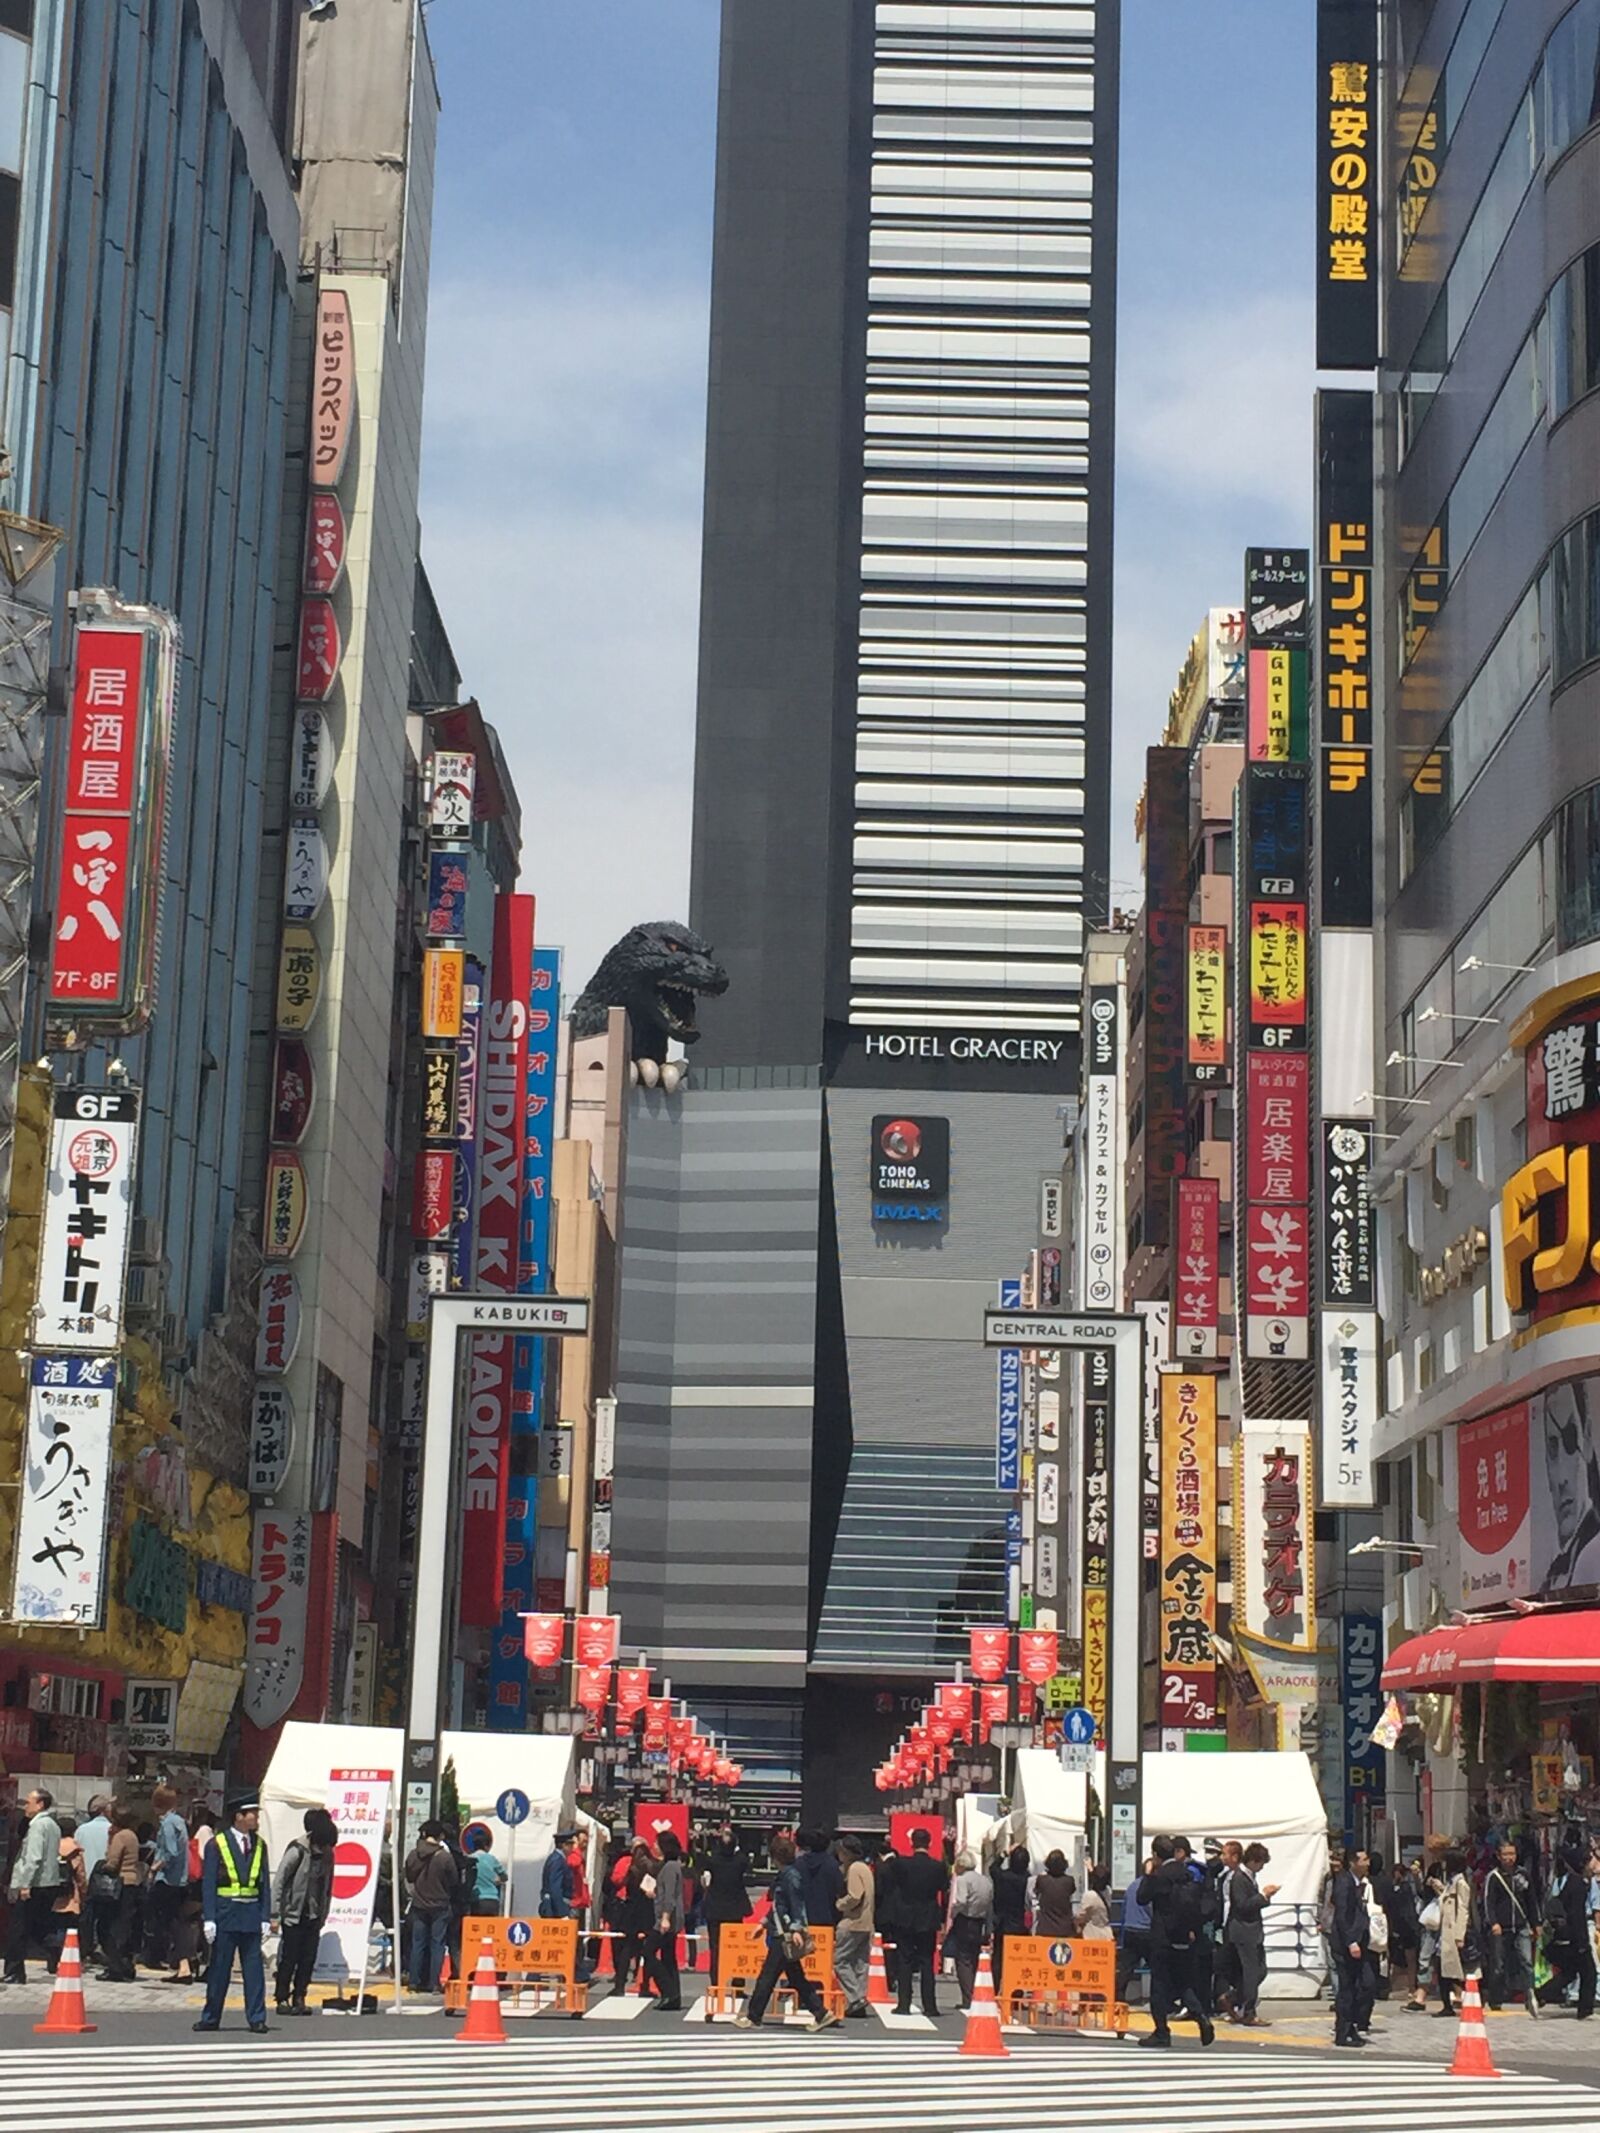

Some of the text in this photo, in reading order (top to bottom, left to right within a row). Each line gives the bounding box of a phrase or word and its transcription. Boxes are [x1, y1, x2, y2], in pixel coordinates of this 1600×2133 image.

[1329, 62, 1368, 281] 驚安の殿堂
[311, 518, 337, 570] つぼ八
[303, 624, 332, 676] つぼ八
[1269, 656, 1288, 738] Garam
[79, 669, 127, 799] 居酒屋
[294, 792, 317, 805] 6F
[57, 830, 122, 942] つぼ八
[1264, 881, 1292, 894] 7F
[285, 955, 314, 1006] 虎の子
[282, 1015, 299, 1026] 4F
[866, 1035, 1063, 1060] HOTEL GRACERY
[1263, 1028, 1293, 1047] 6F
[426, 1056, 449, 1123] 山内農場
[1196, 1067, 1217, 1080] 6F
[76, 1094, 121, 1118] 6F
[480, 1000, 527, 1209] SHIDAX
[76, 1139, 91, 1171] 元祖
[93, 1138, 112, 1171] 東京
[1094, 1083, 1108, 1234] ネットカフェ & カプセル
[1262, 1098, 1294, 1198] 居楽屋
[879, 1166, 916, 1177] TOHO
[879, 1178, 931, 1189] CINEMAS
[274, 1169, 294, 1246] お好み焼き
[874, 1204, 941, 1221] IMAX
[63, 1173, 109, 1314] ヤキトリ
[1329, 1165, 1354, 1295] かんかん商店
[58, 1316, 95, 1335] 本舗
[474, 1306, 568, 1325] KABUKI町
[993, 1323, 1117, 1338] CENTRAL ROAD
[43, 1359, 105, 1385] 酒処
[1339, 1346, 1359, 1454] 写真スタジオ
[1000, 1353, 1018, 1484] カラオケランド
[1176, 1383, 1200, 1517] きんくら酒場
[256, 1471, 277, 1485] B1
[1338, 1464, 1362, 1486] 5F
[1477, 1449, 1507, 1499] 免税
[33, 1421, 93, 1579] うさぎや
[1086, 1470, 1107, 1546] 甘太郎
[1476, 1502, 1508, 1529] Tax Free
[1262, 1447, 1302, 1618] カラオケ
[288, 1516, 309, 1587] 大衆酒場
[1088, 1556, 1107, 1569] 4F
[255, 1523, 289, 1645] トラノコ
[1088, 1570, 1107, 1583] 3F
[70, 1604, 93, 1618] 5F
[1165, 1553, 1214, 1664] 金の蔵
[1089, 1617, 1105, 1737] やきとりセン
[1164, 1676, 1198, 1704] 2F
[1348, 1624, 1377, 1758] カラオケ
[1350, 1768, 1376, 1786] B1
[343, 1792, 370, 1805] 車両
[330, 1808, 381, 1822] 進入禁止
[496, 1949, 563, 1962] 行者専用
[738, 1955, 816, 1969] 歩行用
[1022, 1968, 1100, 1983] 歩行者専用
